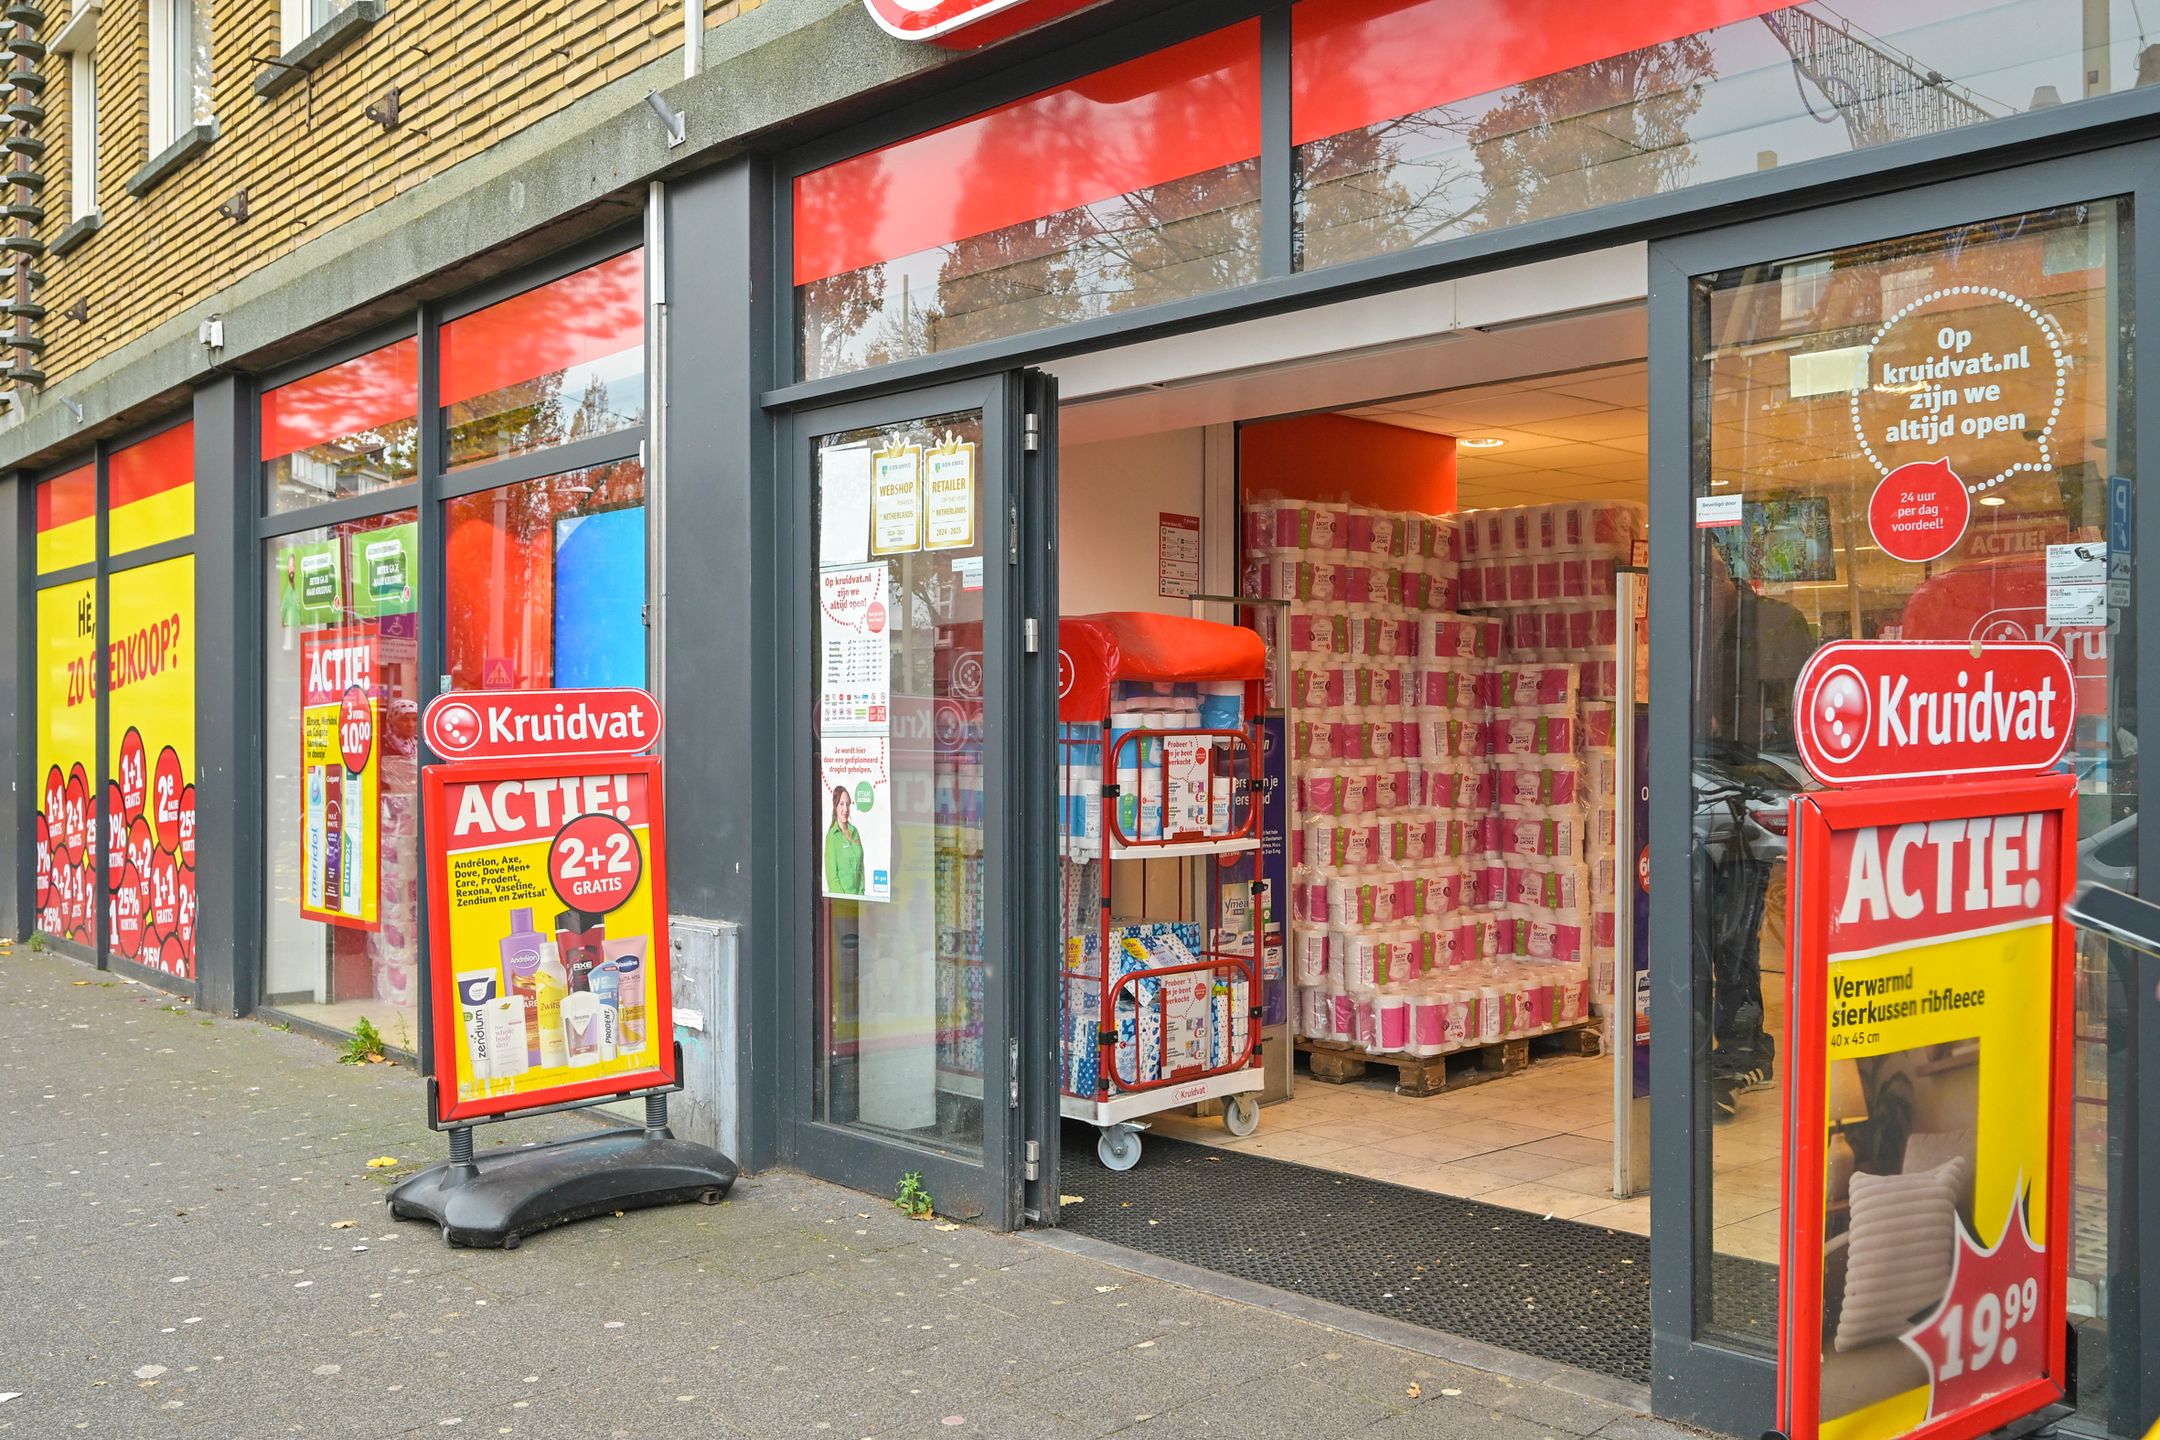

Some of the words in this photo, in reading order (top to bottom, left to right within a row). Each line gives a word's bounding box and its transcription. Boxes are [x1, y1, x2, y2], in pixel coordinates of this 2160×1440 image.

[1937, 327, 1972, 353] Op
[1883, 345, 2030, 385] kruidvat.nl
[1909, 383, 1958, 414] zijn
[1963, 384, 2001, 404] we
[1885, 414, 1955, 445] altijd
[1960, 412, 2026, 440] open
[880, 482, 914, 497] WEBSHOP
[932, 478, 966, 493] RETAILER
[1901, 492, 1914, 503] 24
[1917, 492, 1936, 501] uur
[883, 511, 914, 521] NETHERLANDS
[935, 506, 966, 516] NETHERLANDS
[1897, 507, 1916, 519] per
[1918, 504, 1939, 517] dag
[1891, 518, 1944, 532] voordeel!
[1972, 530, 2046, 555] ACTIE!
[825, 577, 833, 588] Op
[835, 573, 872, 585] kruidvat.nl
[837, 587, 849, 599] zijn
[850, 588, 859, 596] we
[830, 600, 848, 611] altijd
[849, 598, 867, 610] open!
[78, 591, 96, 639] HÈ,
[67, 657, 85, 708] ZO
[89, 613, 180, 699] GEDKOOP?
[309, 645, 370, 693] ACTIE!
[347, 702, 352, 720] 3
[353, 710, 364, 719] VOOR
[1878, 670, 2057, 748] Kruidvat
[487, 702, 645, 743] Kruidvat
[856, 746, 866, 754] hier
[1174, 750, 1180, 758] je
[845, 757, 878, 765] gediplomeerd
[122, 749, 143, 793] 1+1
[1270, 775, 1278, 789] je
[47, 785, 64, 823] 1+1
[124, 791, 141, 809] GRATIS
[453, 774, 631, 836] ACTIE!
[66, 797, 83, 835] 2+1
[454, 858, 499, 869] Andrélon,
[501, 855, 522, 864] Axe,
[558, 833, 632, 879] 2+2
[455, 868, 480, 879] Dove,
[483, 866, 505, 876] Dove
[507, 864, 530, 873] Men+
[1838, 813, 2043, 924] ACTIE!
[153, 865, 175, 907] 1+1
[455, 879, 479, 888] Care,
[481, 874, 520, 886] Prodent,
[572, 877, 622, 896] GRATIS
[456, 887, 492, 898] Rexona,
[495, 882, 536, 893] Vaseline,
[118, 888, 139, 916] 25%
[457, 896, 497, 907] Zendium
[498, 894, 510, 902] en
[156, 908, 173, 923] GRATIS
[573, 961, 593, 971] AXE
[1164, 979, 1186, 987] Probeer
[1833, 966, 1913, 1000] Verwarmd
[1172, 988, 1178, 997] je
[540, 1001, 560, 1011] Zwits
[1831, 997, 1917, 1028] sierkussen
[1921, 988, 1985, 1014] ribfleece
[475, 1009, 486, 1059] zendium
[1831, 1033, 1842, 1047] 40
[1844, 1035, 1850, 1046] x
[1852, 1032, 1865, 1045] 45
[1867, 1032, 1880, 1044] cm
[1180, 1086, 1206, 1099] Kruidvat
